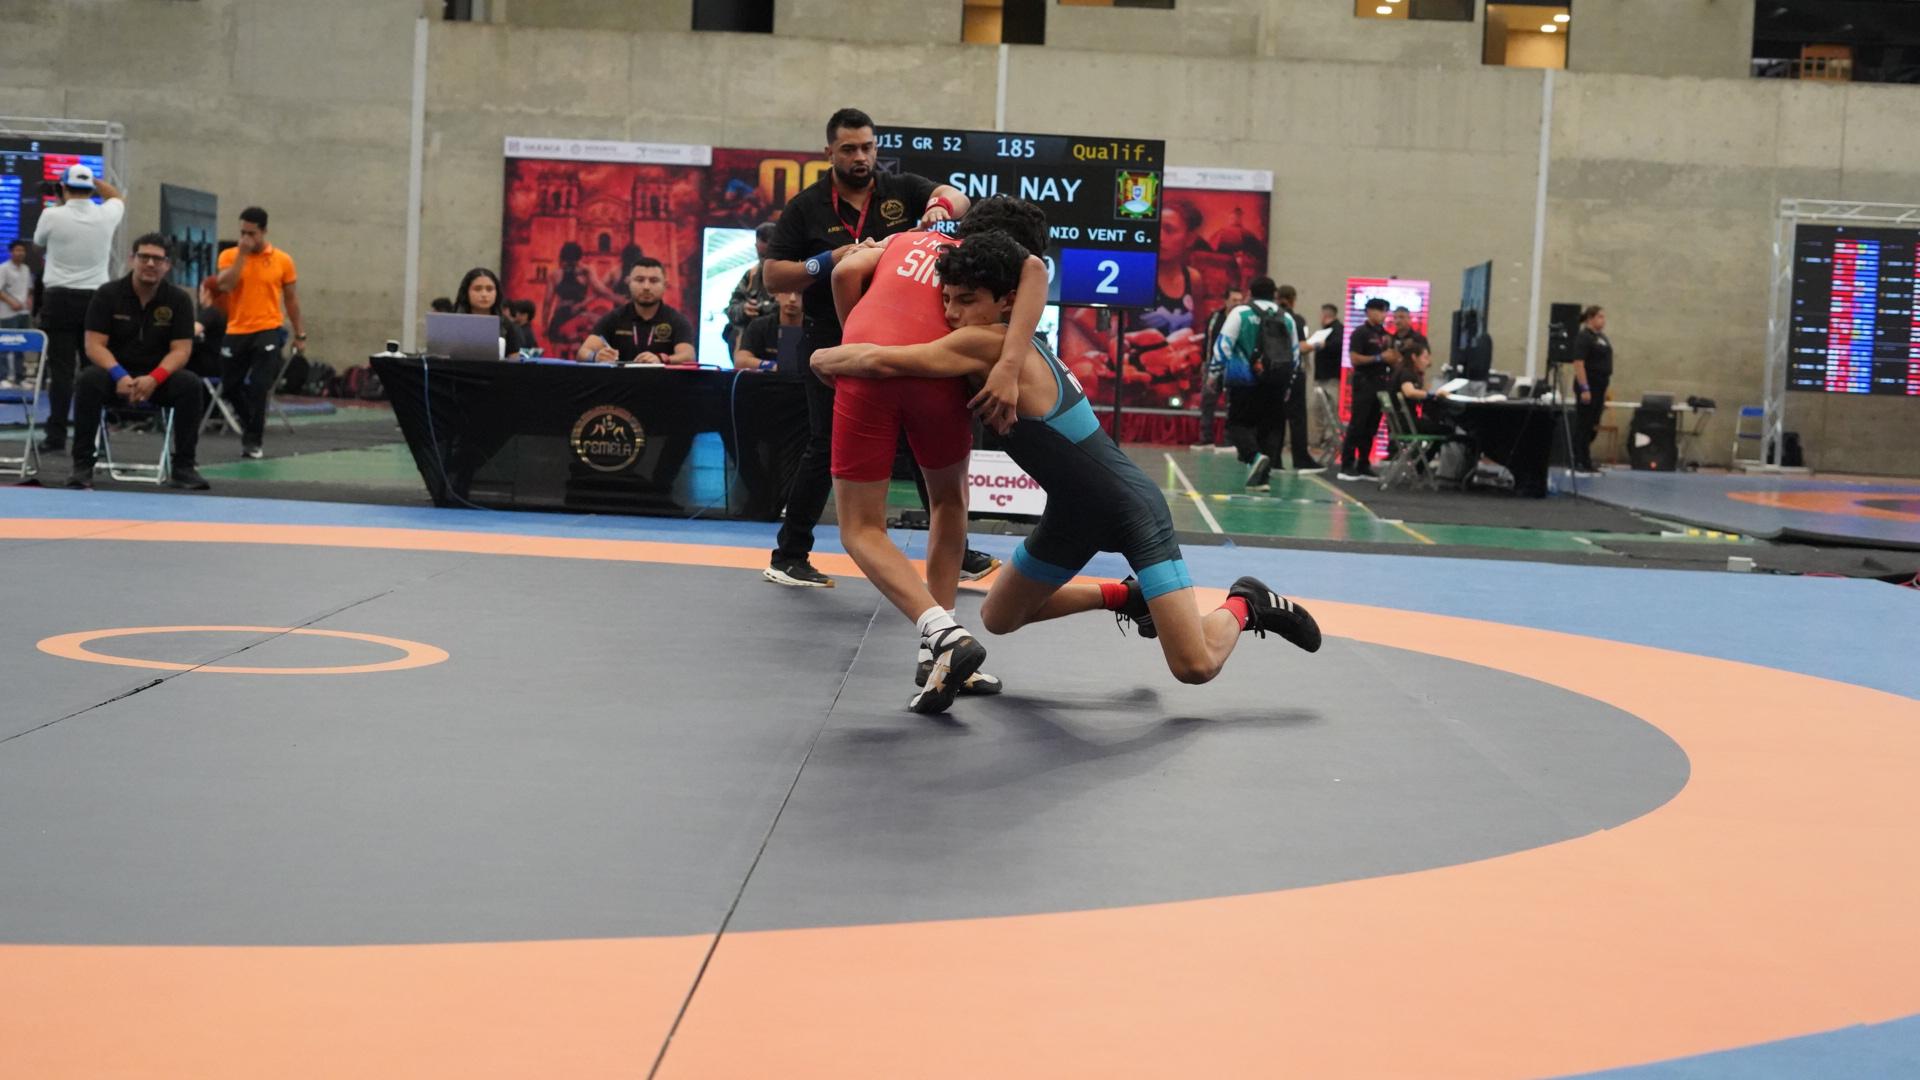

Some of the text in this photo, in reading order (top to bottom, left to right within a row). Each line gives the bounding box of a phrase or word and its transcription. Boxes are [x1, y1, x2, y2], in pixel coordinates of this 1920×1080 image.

[912, 136, 933, 151] GR
[942, 137, 962, 151] 52
[996, 138, 1035, 158] 185
[1072, 142, 1153, 161] Qualif.
[1020, 176, 1082, 203] NAY
[1087, 228, 1127, 242] VENT
[1134, 230, 1152, 244] G.
[1095, 259, 1121, 294] 2
